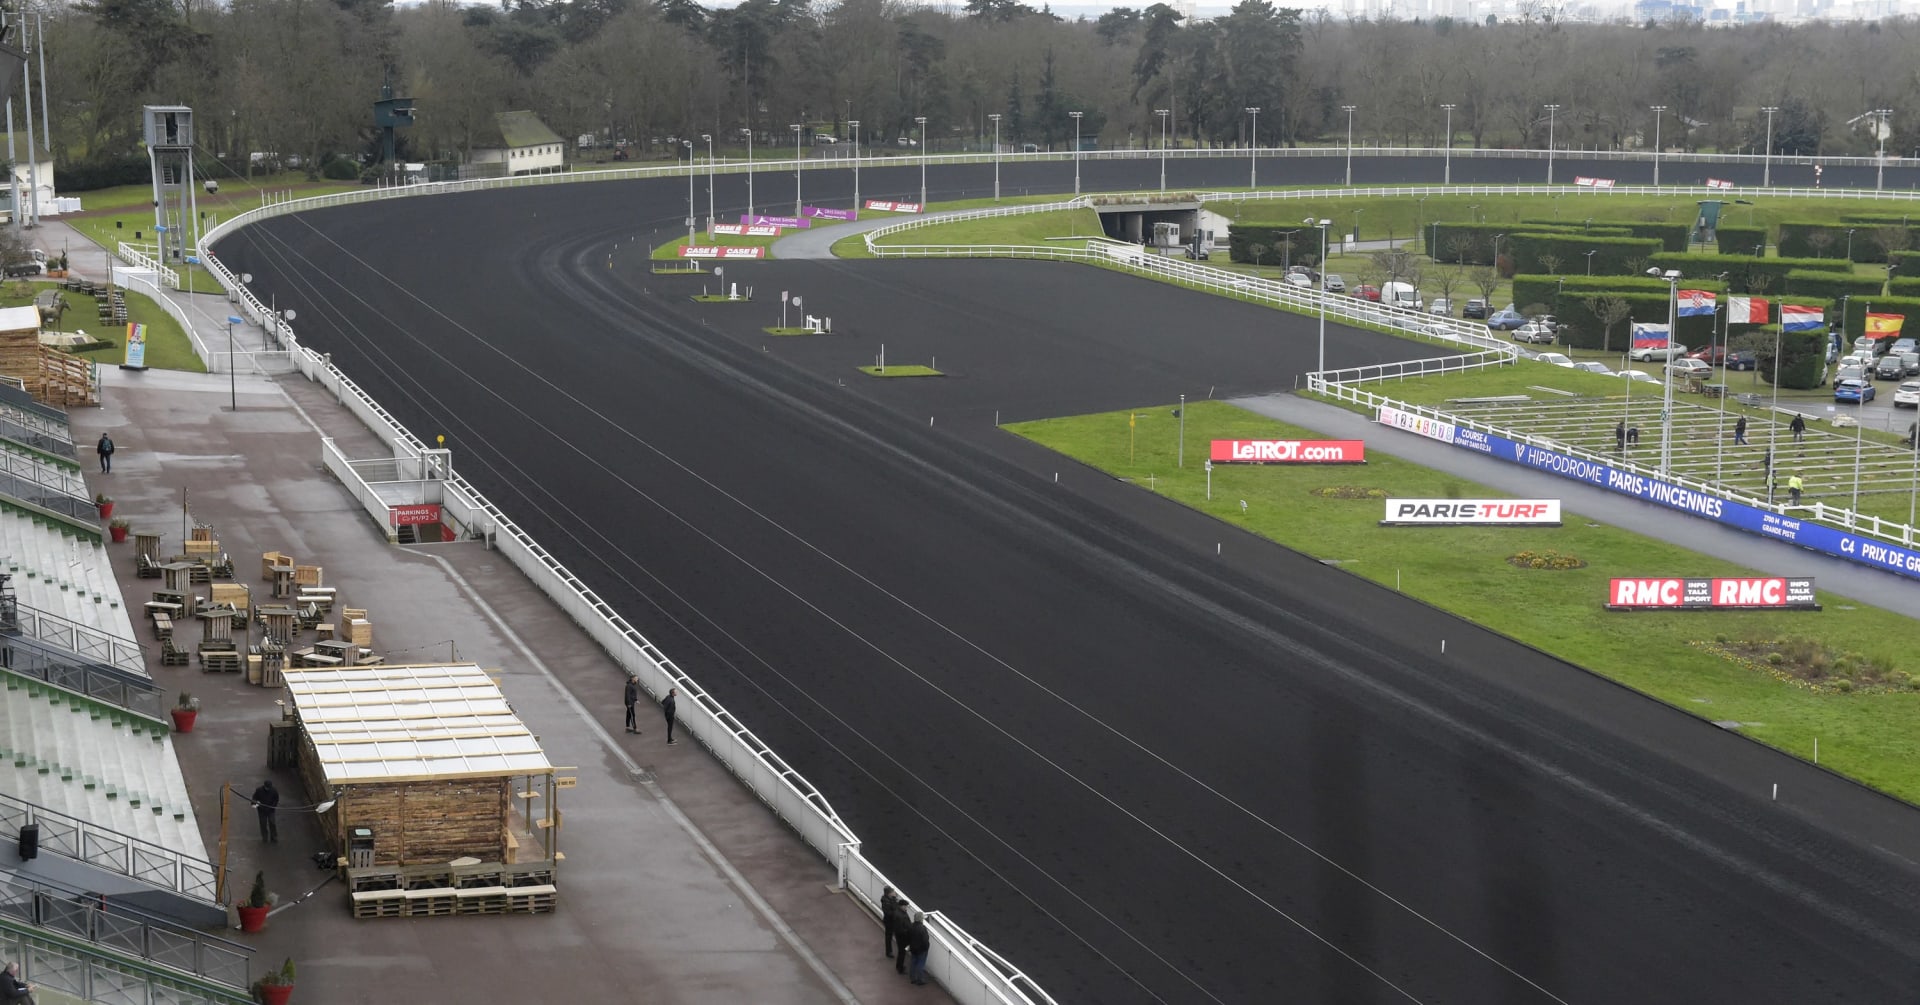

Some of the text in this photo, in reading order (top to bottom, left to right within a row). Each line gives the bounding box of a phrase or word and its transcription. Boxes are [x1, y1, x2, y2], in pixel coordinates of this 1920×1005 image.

[1394, 413, 1398, 424] 1
[1401, 414, 1406, 426] 2
[1408, 417, 1413, 428] 3
[1416, 419, 1421, 431] 4
[1424, 421, 1429, 433] 5
[1431, 423, 1436, 435] 6
[1439, 425, 1444, 437] 7
[1461, 429, 1488, 444] COURSE 4
[1232, 440, 1343, 460] LeTROT.com
[1527, 448, 1723, 518] HIPPODROME PARIS-VINCENNES
[397, 508, 429, 516] PARKINGS
[1397, 504, 1548, 518] PARIS-TURF
[1762, 524, 1795, 539] GRANDE PISTE
[1782, 519, 1800, 531] MONTÉ
[1840, 538, 1855, 554] C4
[1861, 543, 1888, 563] PRIX
[1888, 550, 1905, 568] DE
[1617, 579, 1680, 605] RMC
[1719, 579, 1782, 604] RMC
